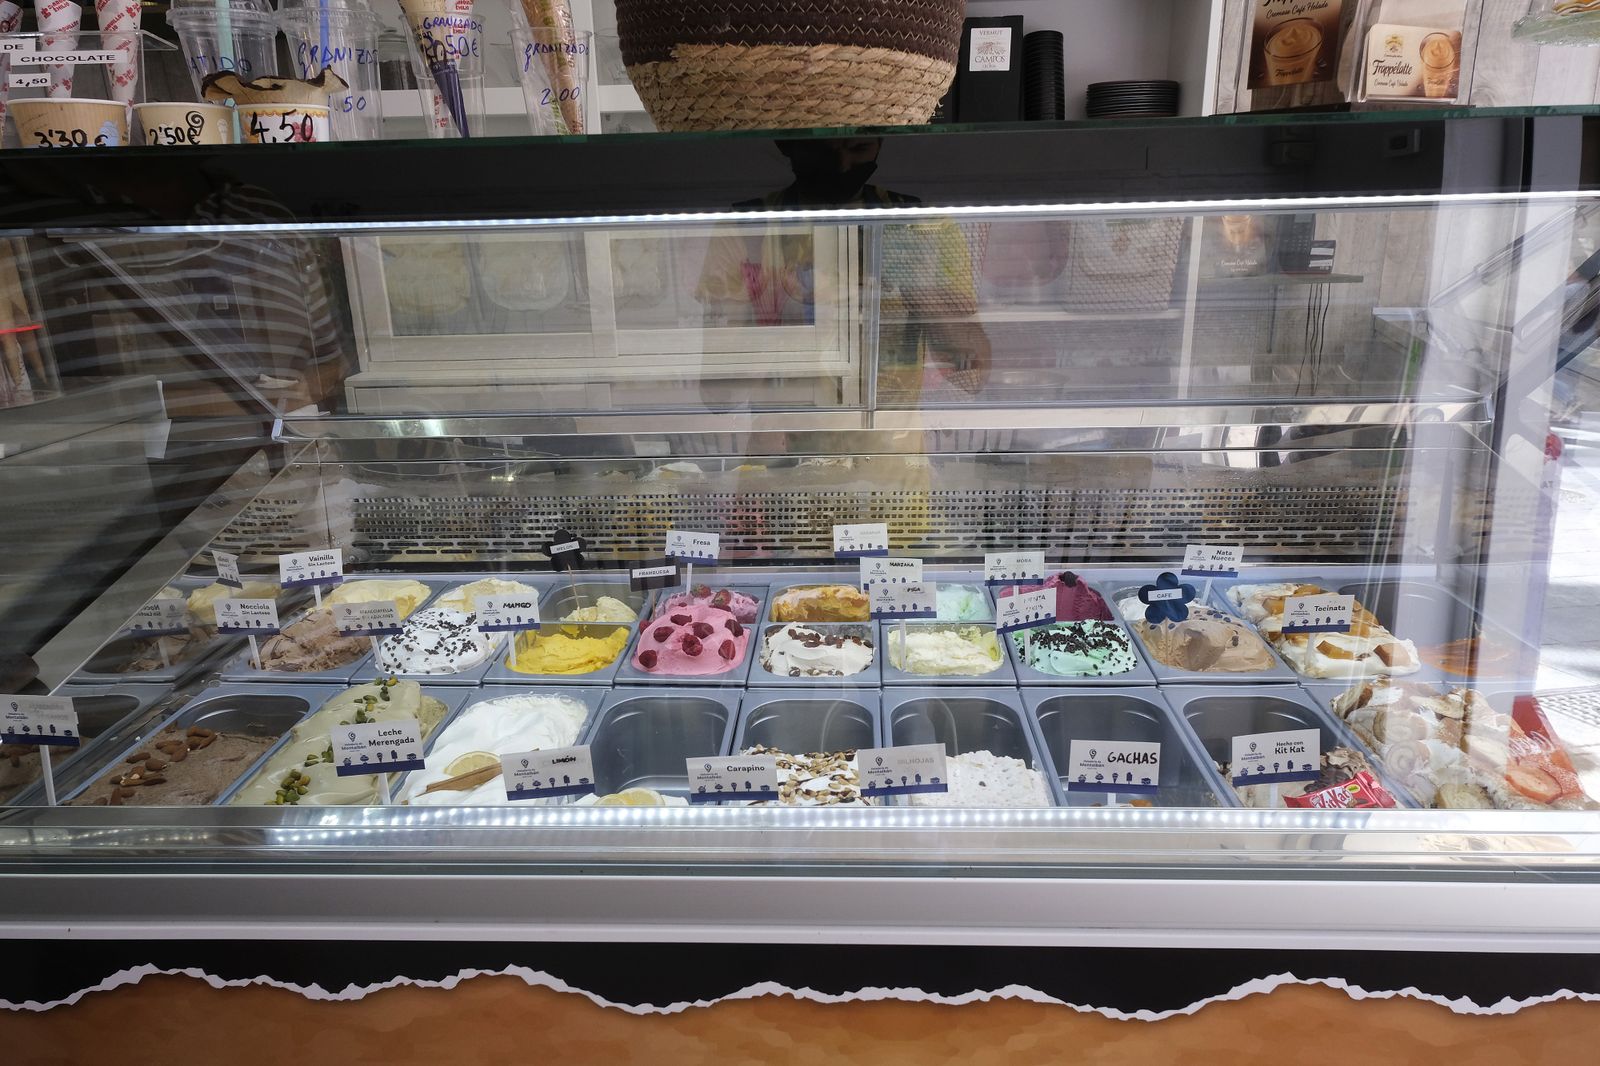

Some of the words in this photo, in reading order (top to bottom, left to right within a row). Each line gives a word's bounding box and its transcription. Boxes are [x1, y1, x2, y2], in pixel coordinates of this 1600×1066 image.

[423, 16, 483, 34] GRANIZADO
[21, 54, 116, 63] CHOCOLATE
[974, 55, 1006, 64] CAMPOS
[16, 78, 48, 87] 4,50
[250, 109, 314, 144] 4,50
[692, 539, 711, 549] Fresa
[240, 603, 270, 611] Nocciola
[1314, 604, 1346, 612] Tocinata
[377, 728, 403, 737] Leche
[368, 736, 415, 748] Merengada
[1274, 746, 1288, 755] Kit
[1290, 744, 1306, 754] Kat
[1107, 751, 1158, 765] GACHAS
[726, 764, 766, 774] Carapino
